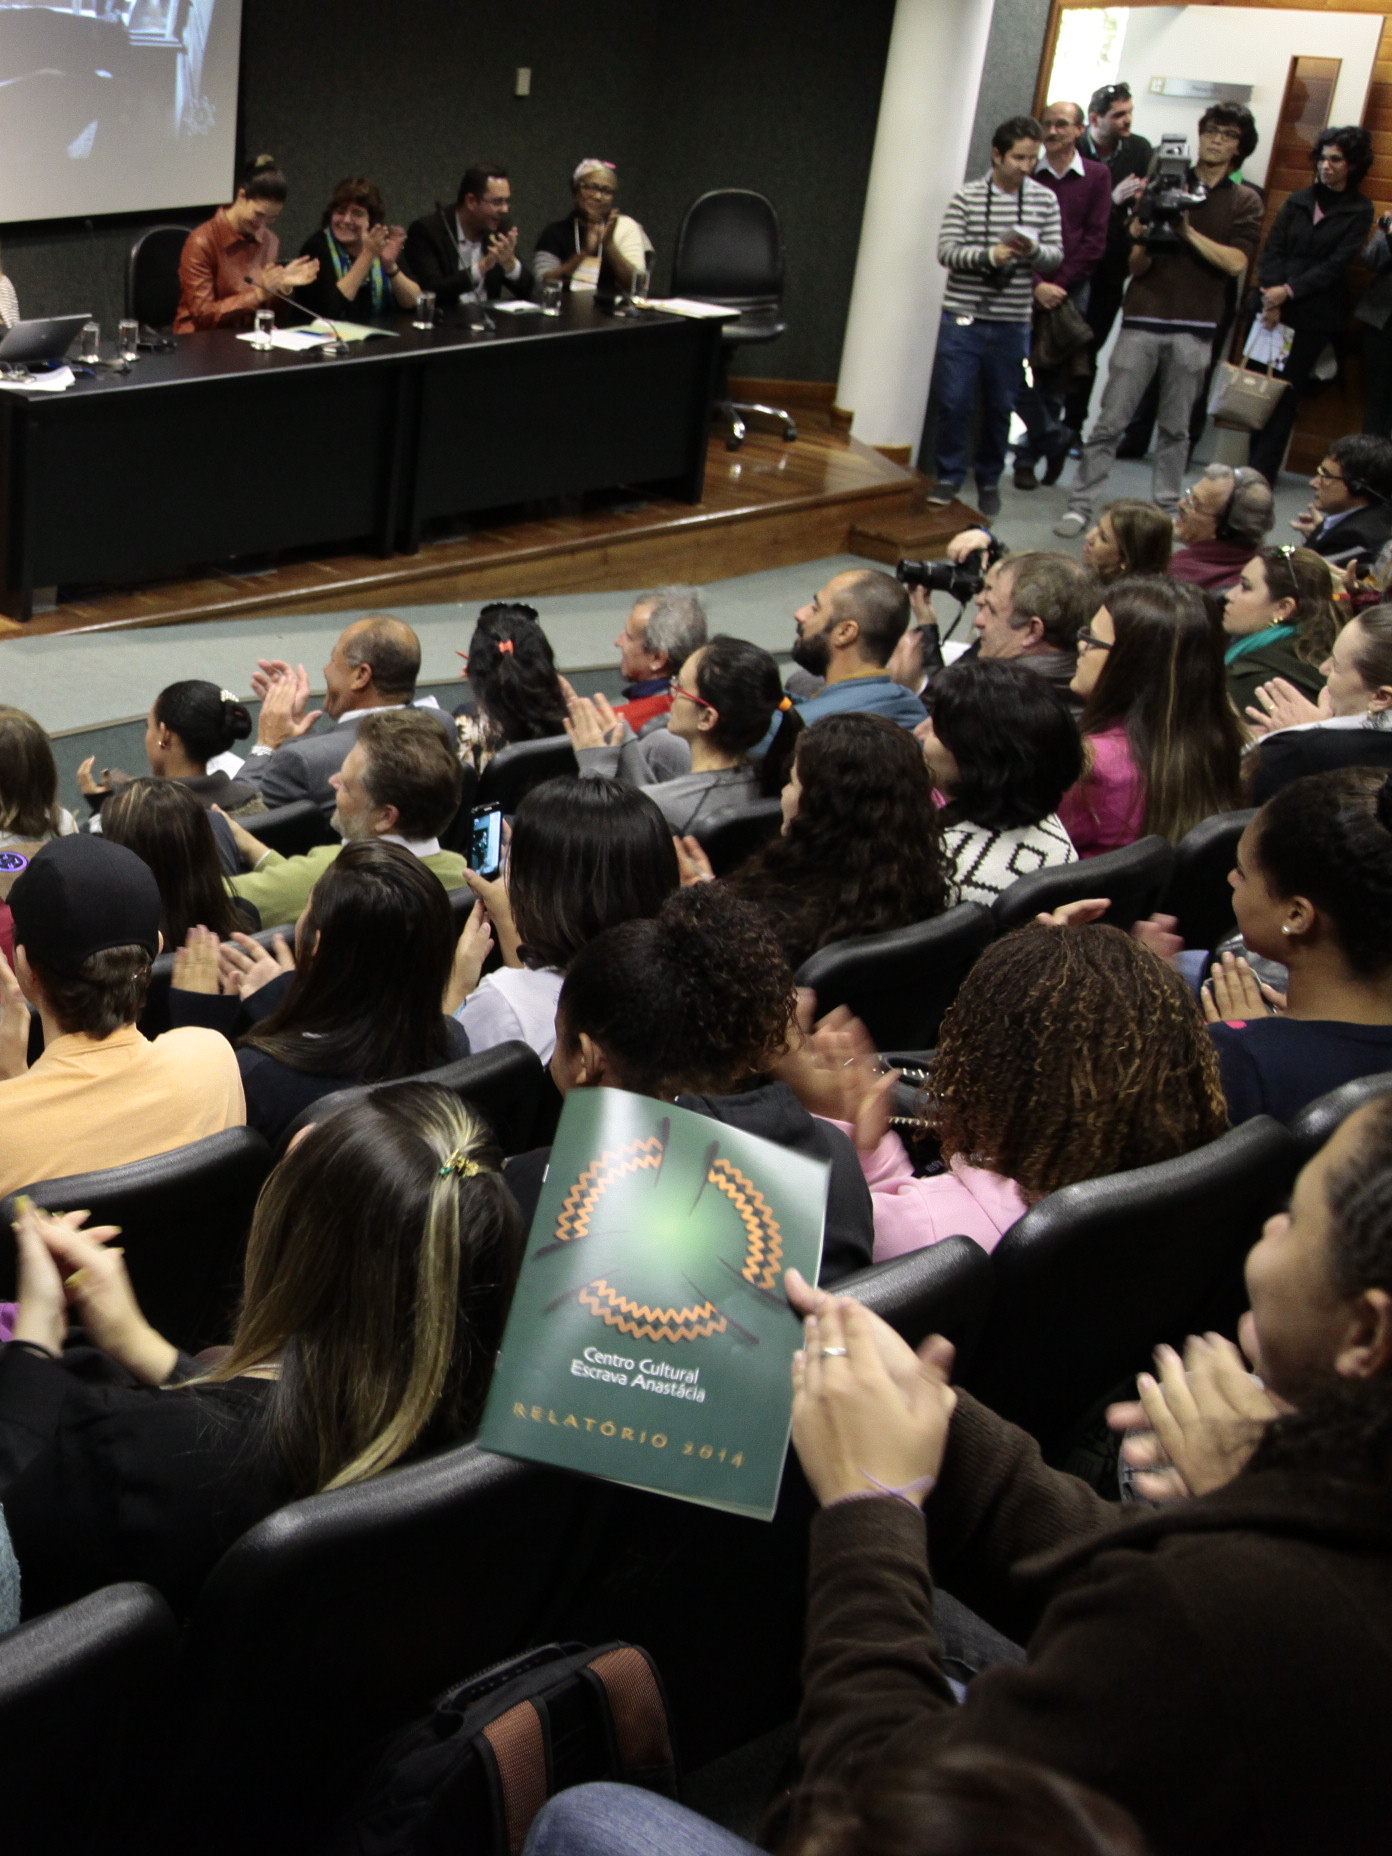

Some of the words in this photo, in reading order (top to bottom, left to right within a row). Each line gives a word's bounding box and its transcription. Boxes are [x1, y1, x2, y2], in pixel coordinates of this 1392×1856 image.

[570, 1358, 628, 1386] Escrava
[630, 1374, 706, 1403] Anastácia
[583, 1346, 635, 1370] Centro
[639, 1359, 700, 1384] Cultural
[512, 1402, 668, 1448] RELATÓRIO
[682, 1441, 745, 1468] 2014
